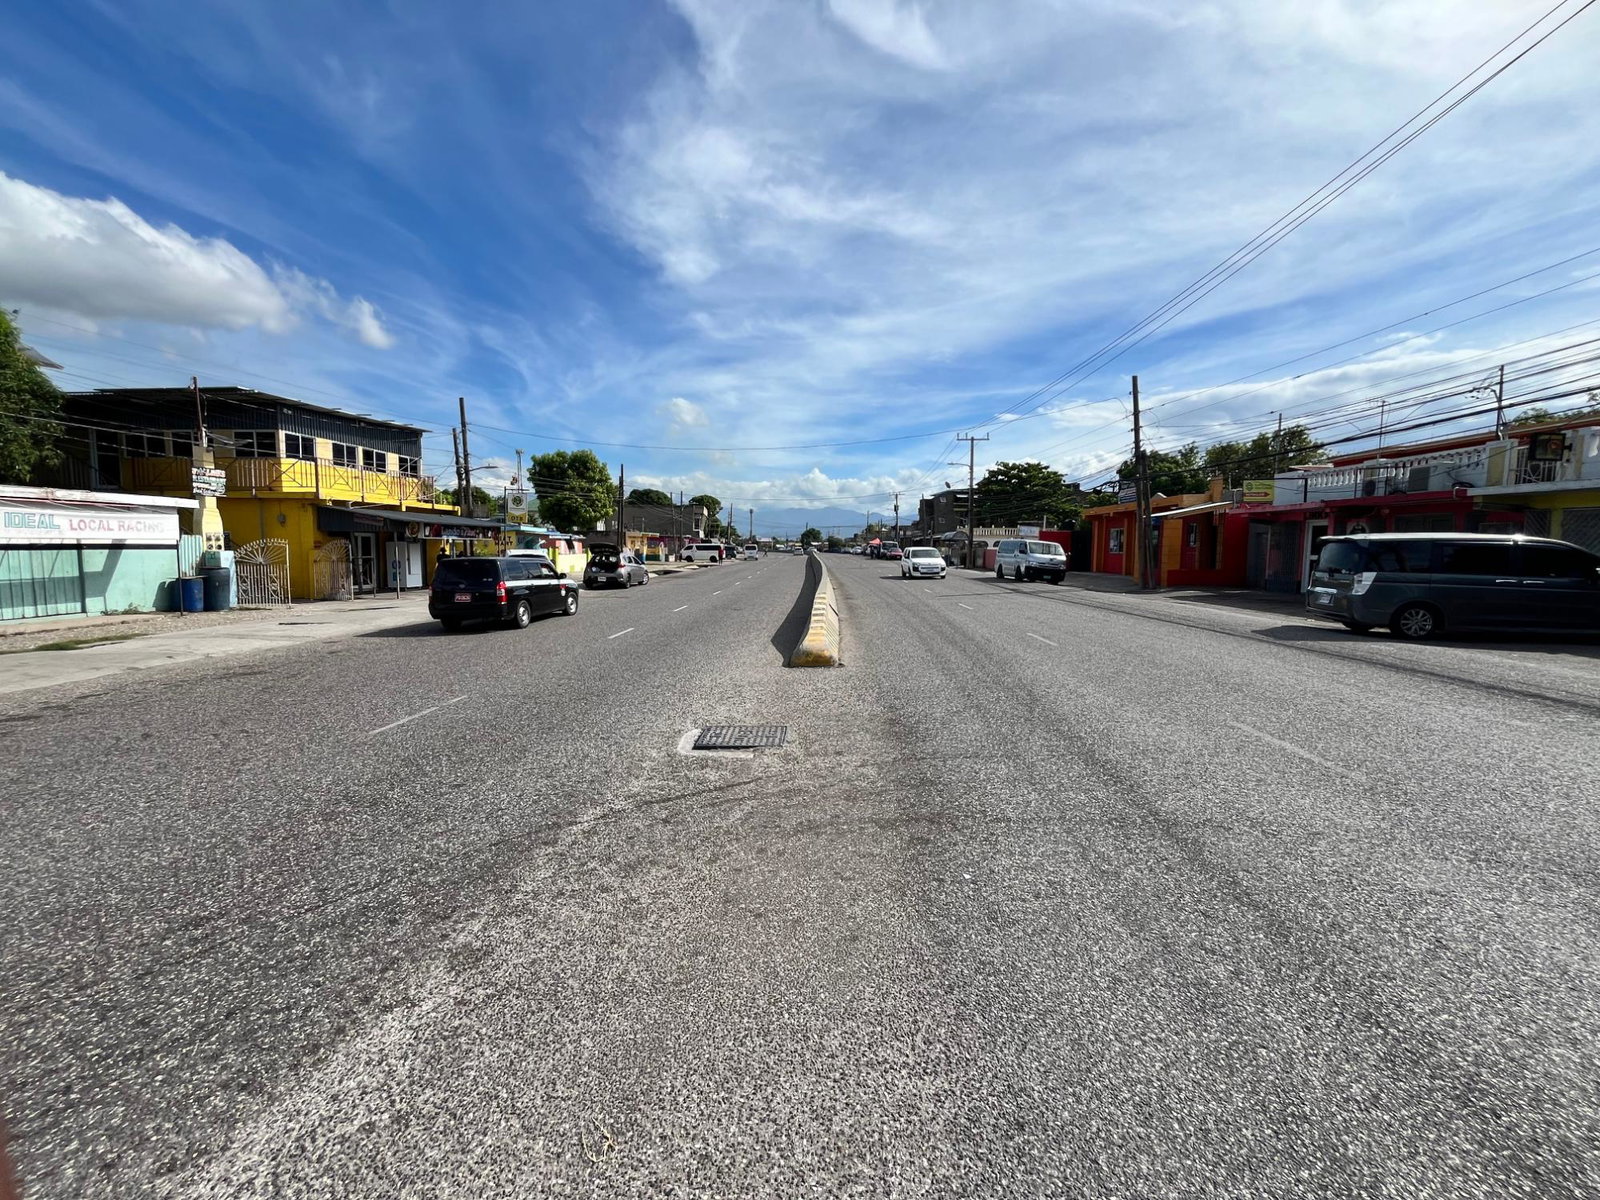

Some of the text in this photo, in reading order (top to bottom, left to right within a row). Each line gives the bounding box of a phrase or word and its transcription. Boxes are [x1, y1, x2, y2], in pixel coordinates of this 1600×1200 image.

[4, 511, 165, 533] IDEAL LOCAL RACING
